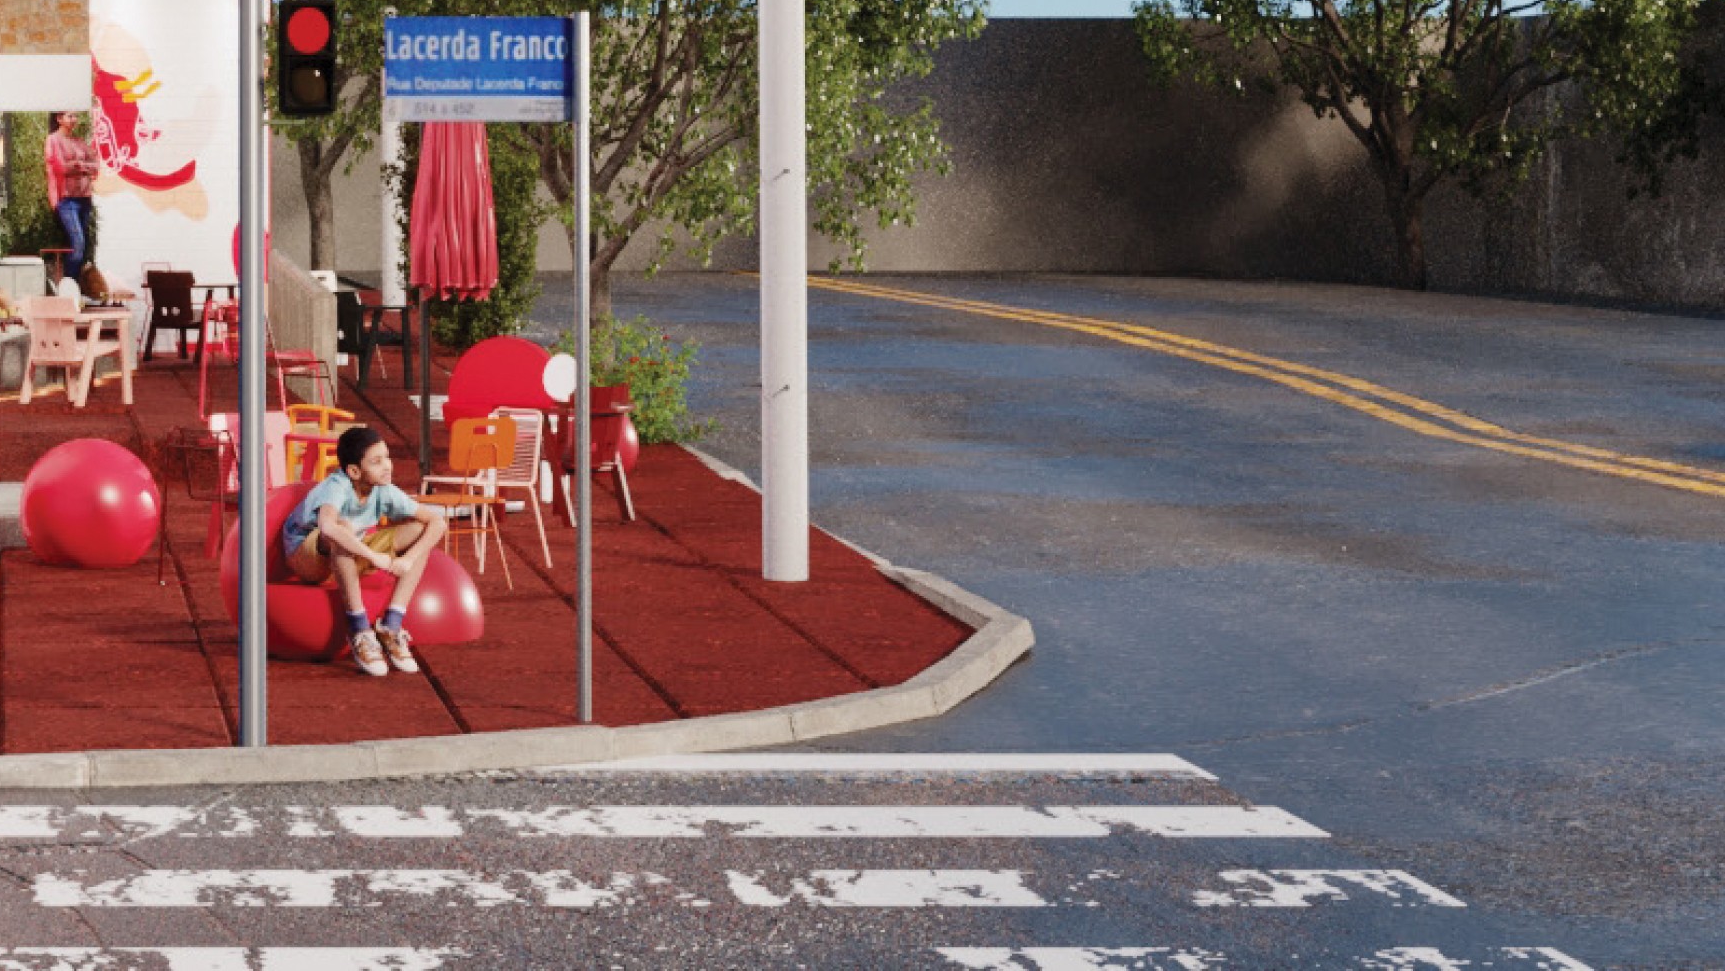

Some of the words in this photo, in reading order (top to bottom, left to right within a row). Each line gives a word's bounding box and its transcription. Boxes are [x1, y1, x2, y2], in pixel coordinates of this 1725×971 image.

[386, 28, 480, 61] Lacerda
[489, 30, 567, 61] Franco
[386, 76, 411, 90] Rua
[475, 76, 525, 90] Lacerda
[527, 76, 564, 90] Franc
